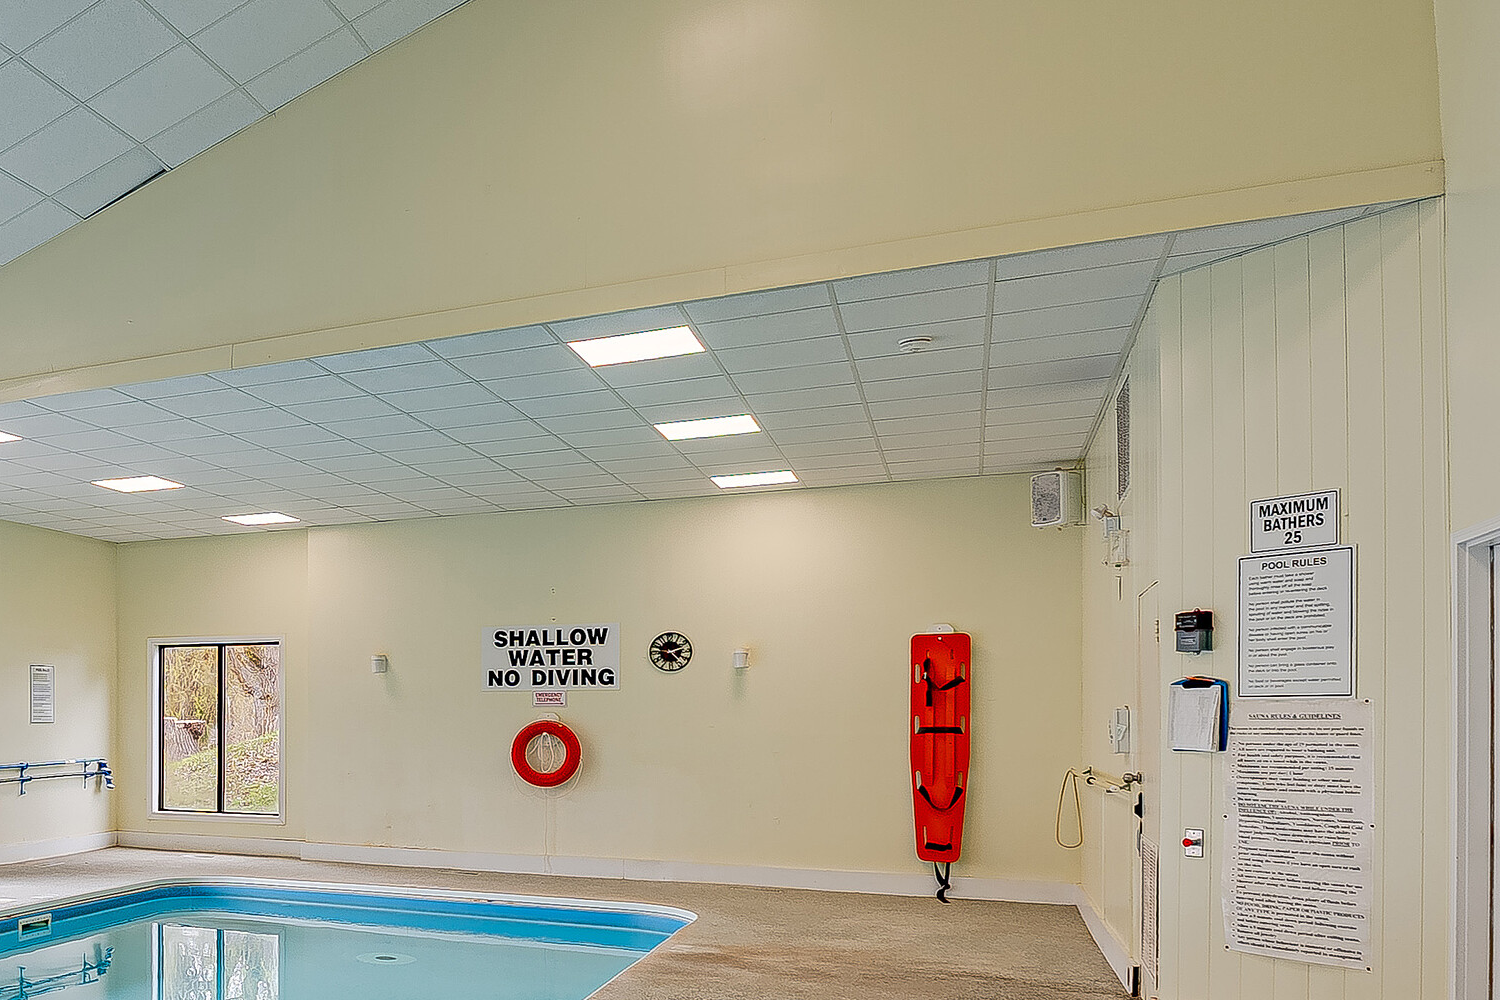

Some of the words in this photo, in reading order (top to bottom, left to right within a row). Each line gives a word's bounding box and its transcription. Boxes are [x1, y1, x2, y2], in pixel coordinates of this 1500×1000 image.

[1260, 496, 1328, 518] MAXIMUM
[1264, 513, 1324, 532] BATHERS
[1284, 531, 1302, 544] 25
[1262, 562, 1290, 570] POOL
[1292, 557, 1326, 568] RULES
[494, 628, 608, 647] SHALLOW
[508, 649, 592, 666] WATER
[488, 670, 520, 686] NO
[532, 668, 615, 686] DIVING
